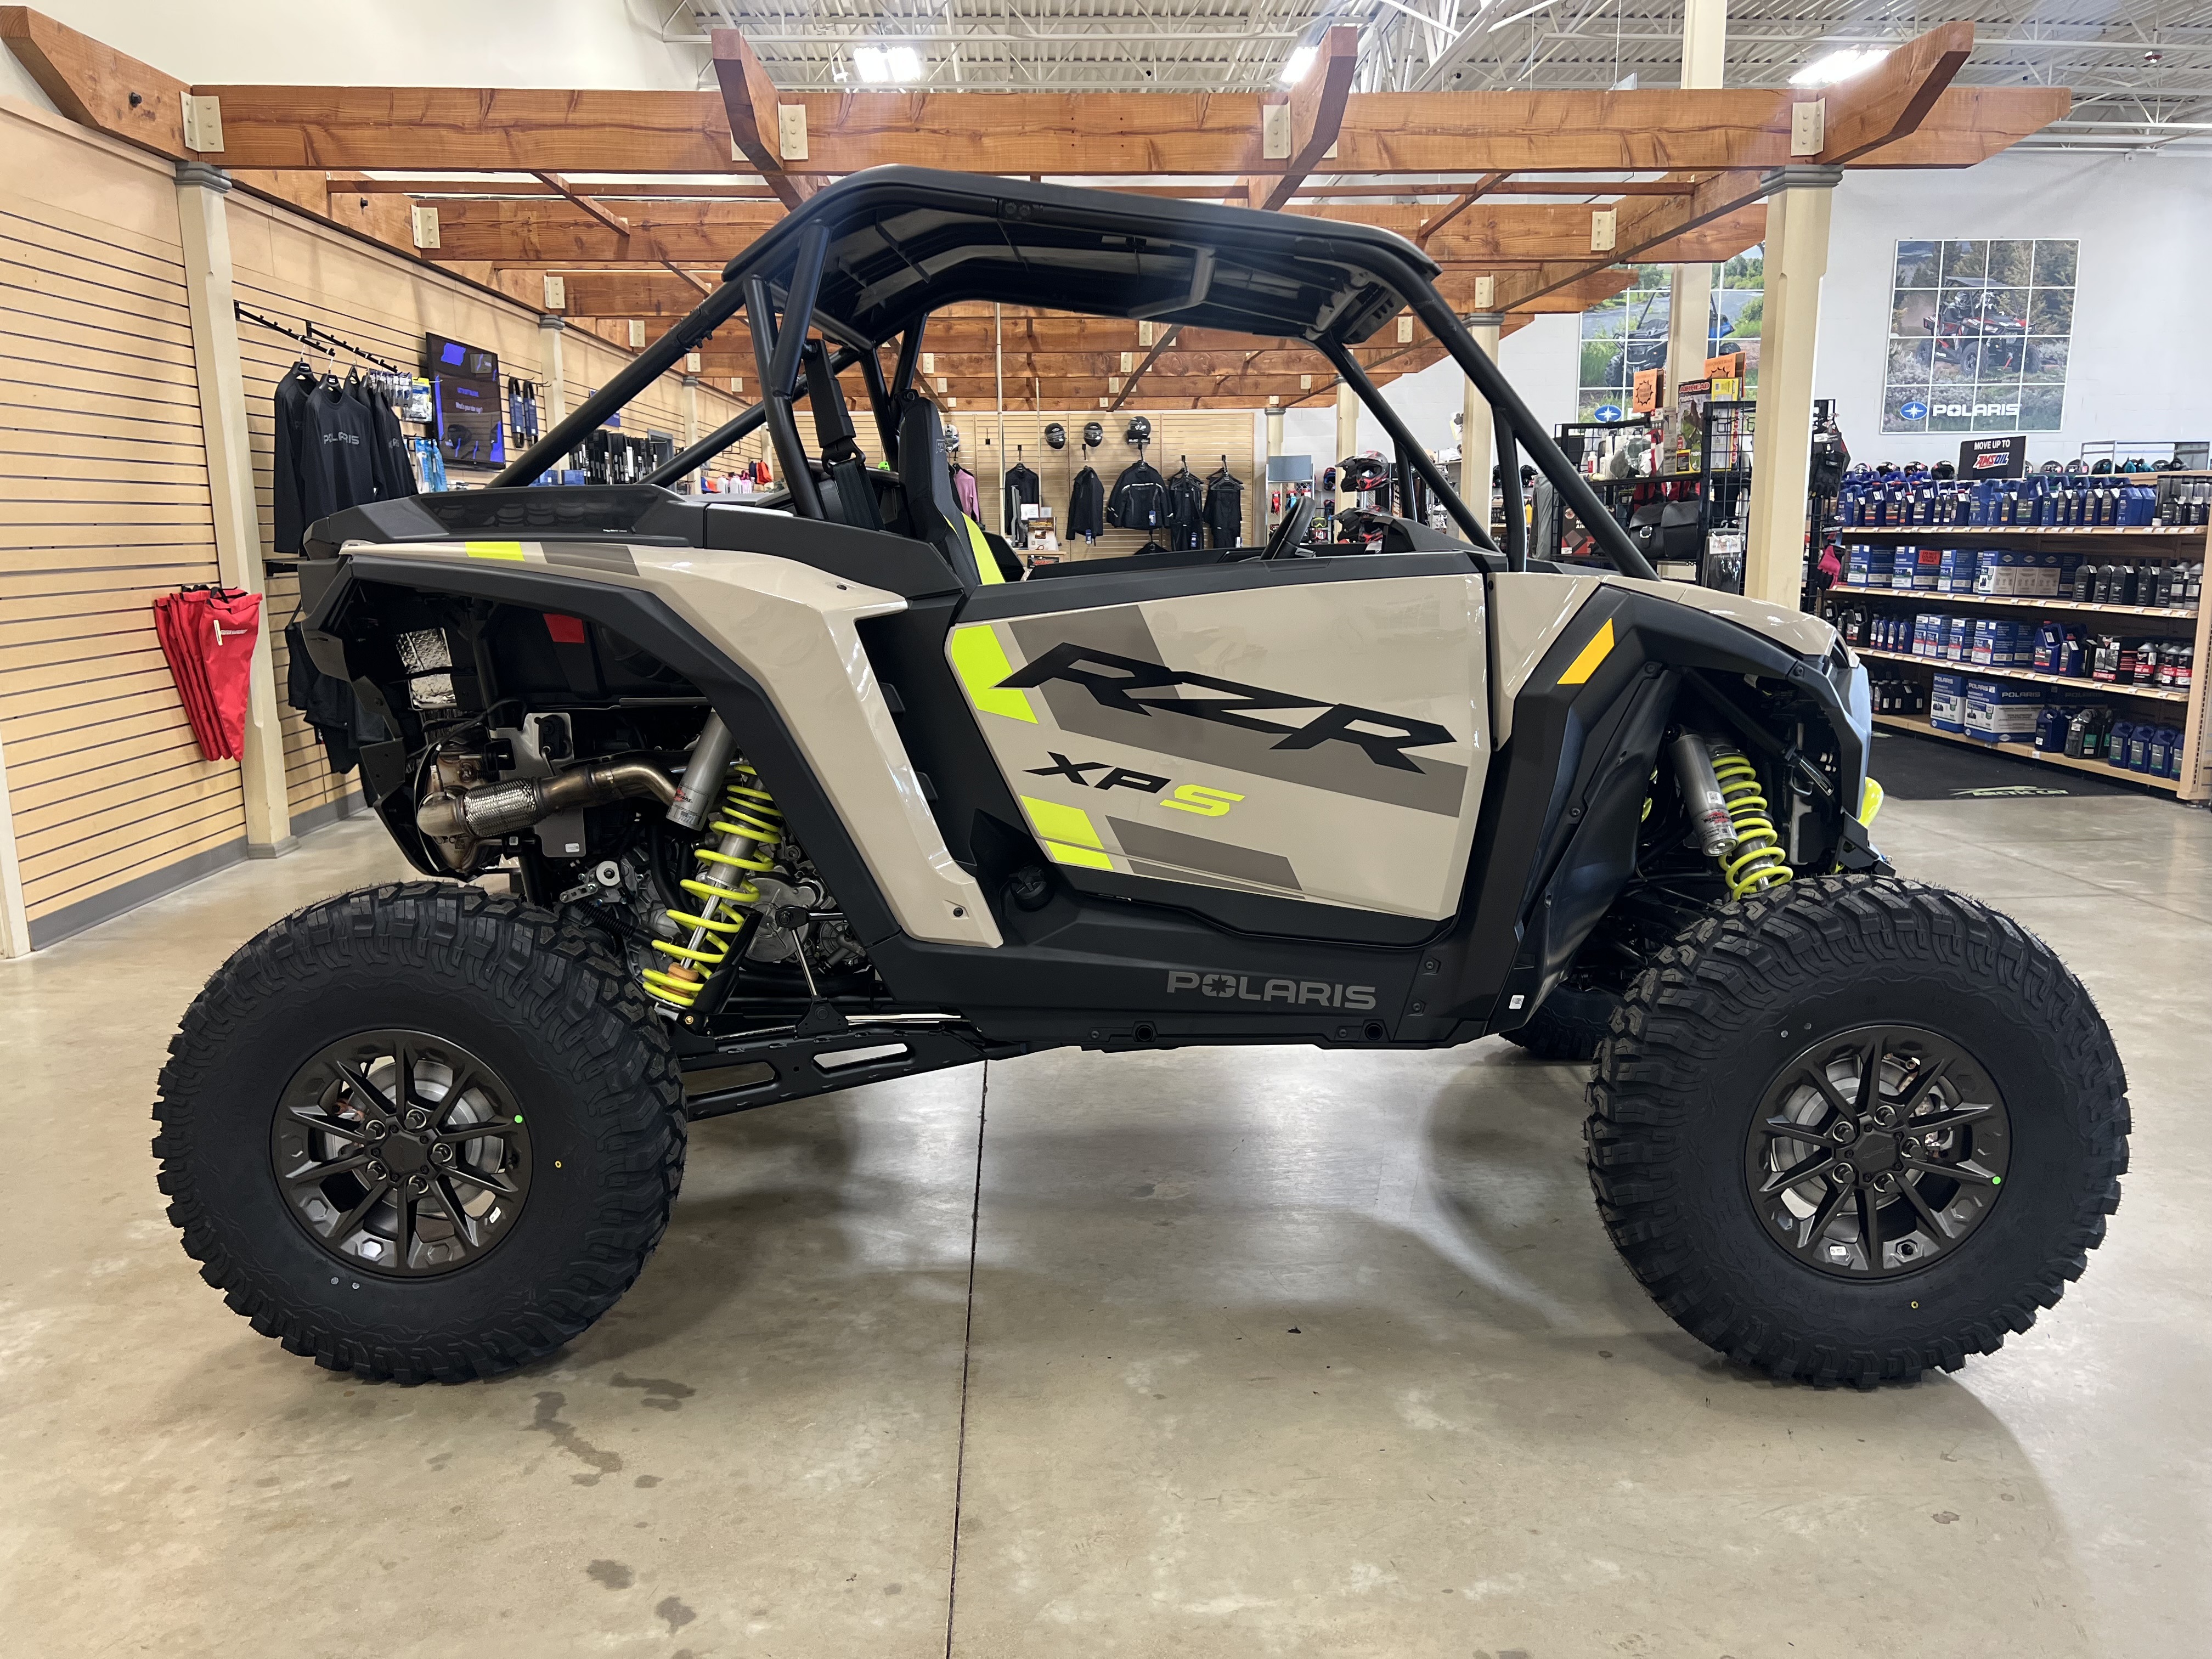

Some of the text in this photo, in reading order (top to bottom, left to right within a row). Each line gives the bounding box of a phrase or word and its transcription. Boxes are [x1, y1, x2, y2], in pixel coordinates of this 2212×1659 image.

[1679, 381, 1711, 393] AIRHEAD
[1932, 403, 2018, 417] POLARIS
[323, 431, 360, 445] POLARIS
[1974, 439, 2011, 450] MOVE UP TO
[1974, 453, 2009, 469] AMSOIL
[1934, 675, 1954, 685] POLARIS
[1968, 682, 1989, 692] POLARIS
[989, 642, 1457, 775] RZR
[1166, 970, 1376, 1011] POLARIS
